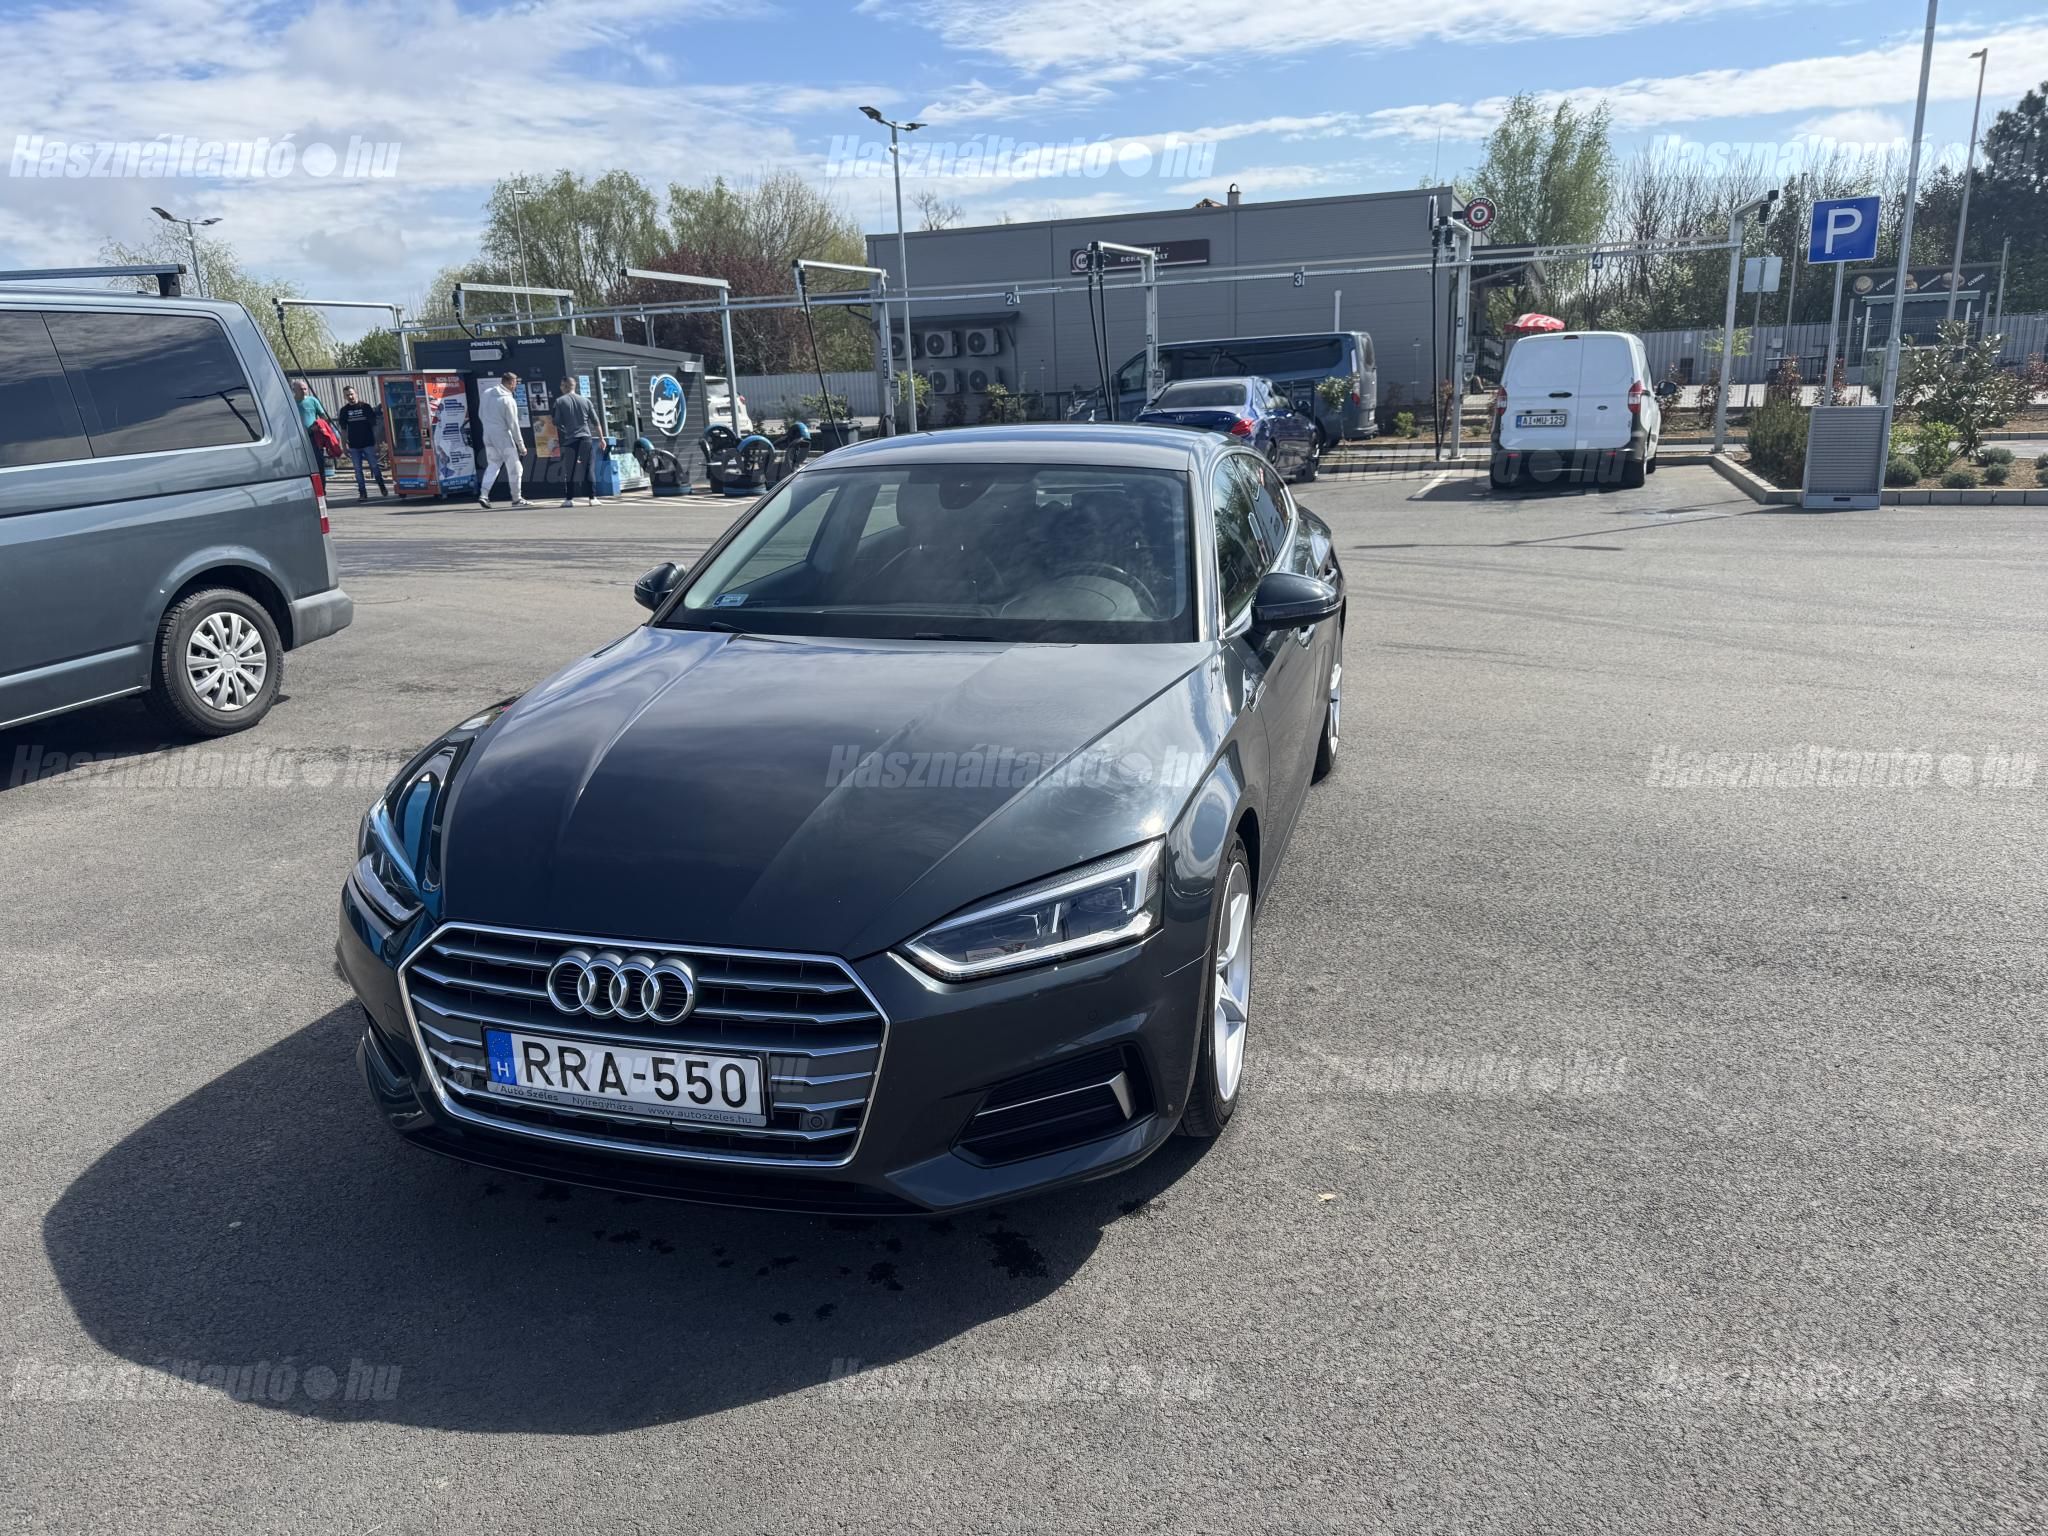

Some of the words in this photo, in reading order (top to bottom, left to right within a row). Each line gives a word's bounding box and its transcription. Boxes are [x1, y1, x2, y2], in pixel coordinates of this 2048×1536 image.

[1825, 207, 1863, 254] P
[1593, 254, 1602, 267] 4
[1294, 273, 1302, 286] 3
[1006, 293, 1014, 305] 2
[497, 1061, 510, 1078] H
[522, 1041, 747, 1108] RRA-550
[647, 1106, 752, 1124] www.autoszeles.hu
